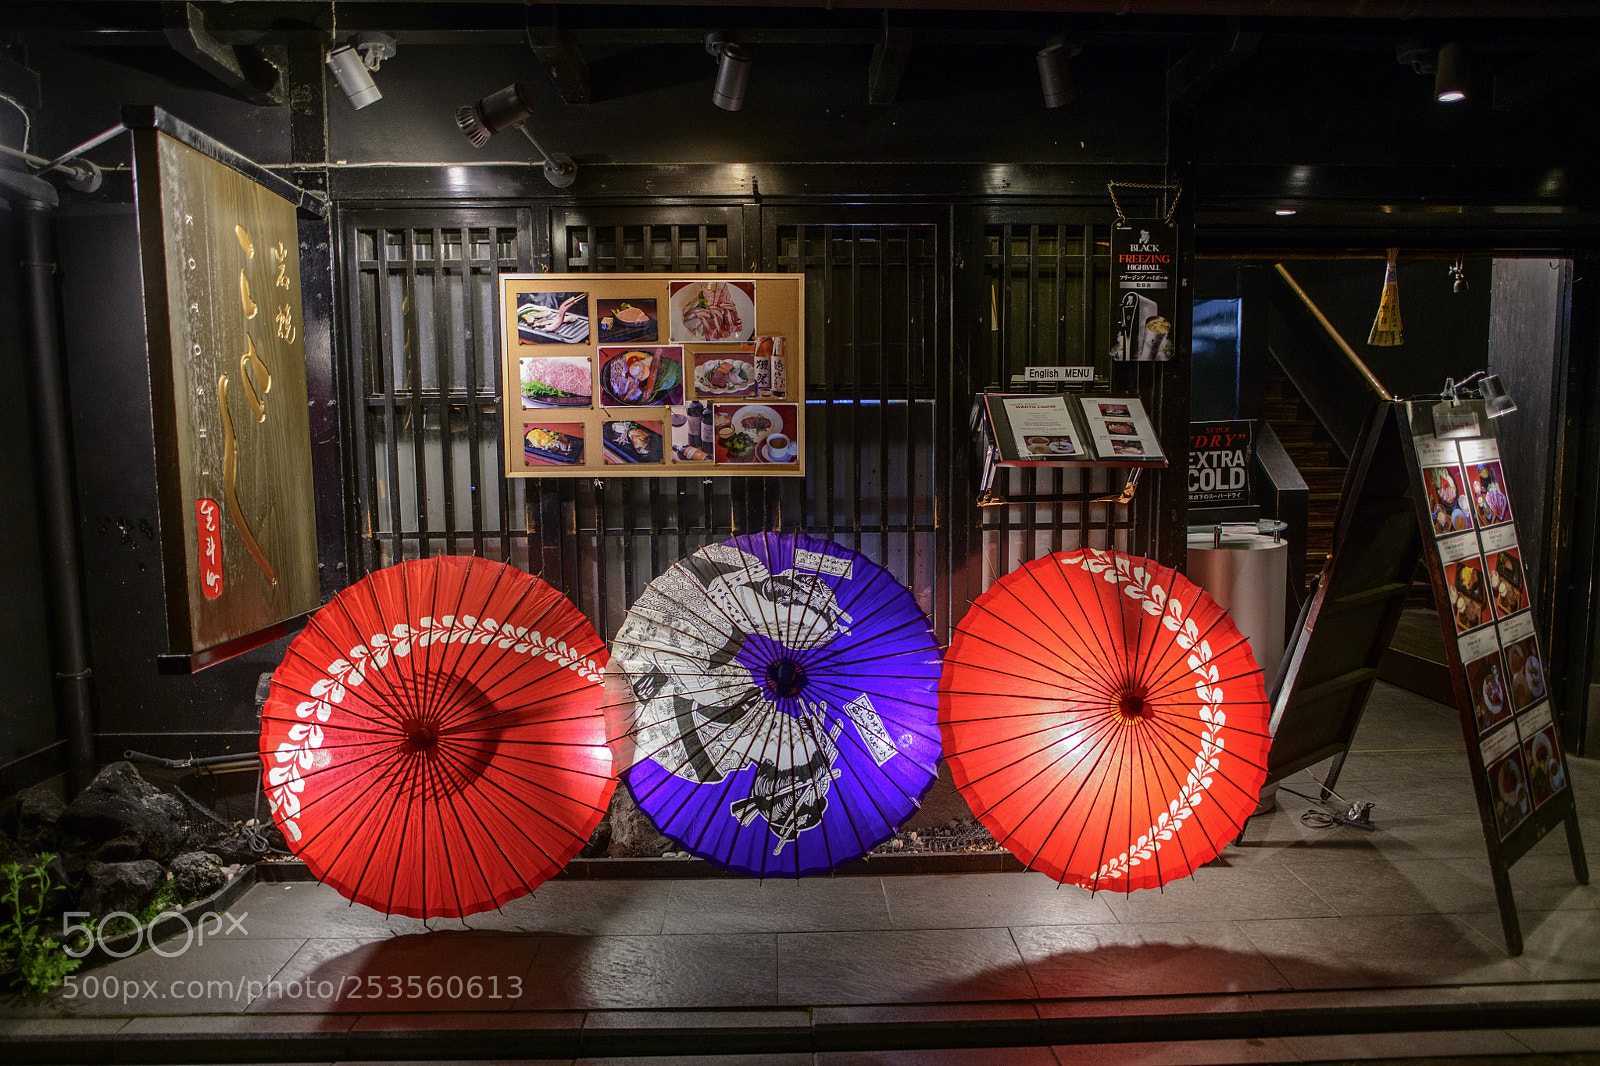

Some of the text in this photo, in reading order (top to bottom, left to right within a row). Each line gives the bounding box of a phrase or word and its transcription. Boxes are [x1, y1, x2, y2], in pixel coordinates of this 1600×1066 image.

[1129, 244, 1160, 252] BLACK
[1119, 254, 1170, 264] FREEZING
[184, 214, 210, 476] KOTOSHI
[1029, 368, 1090, 379] English MENU
[1205, 426, 1230, 434] SUPER
[1188, 449, 1246, 469] EXTRA
[1187, 467, 1246, 492] COLD
